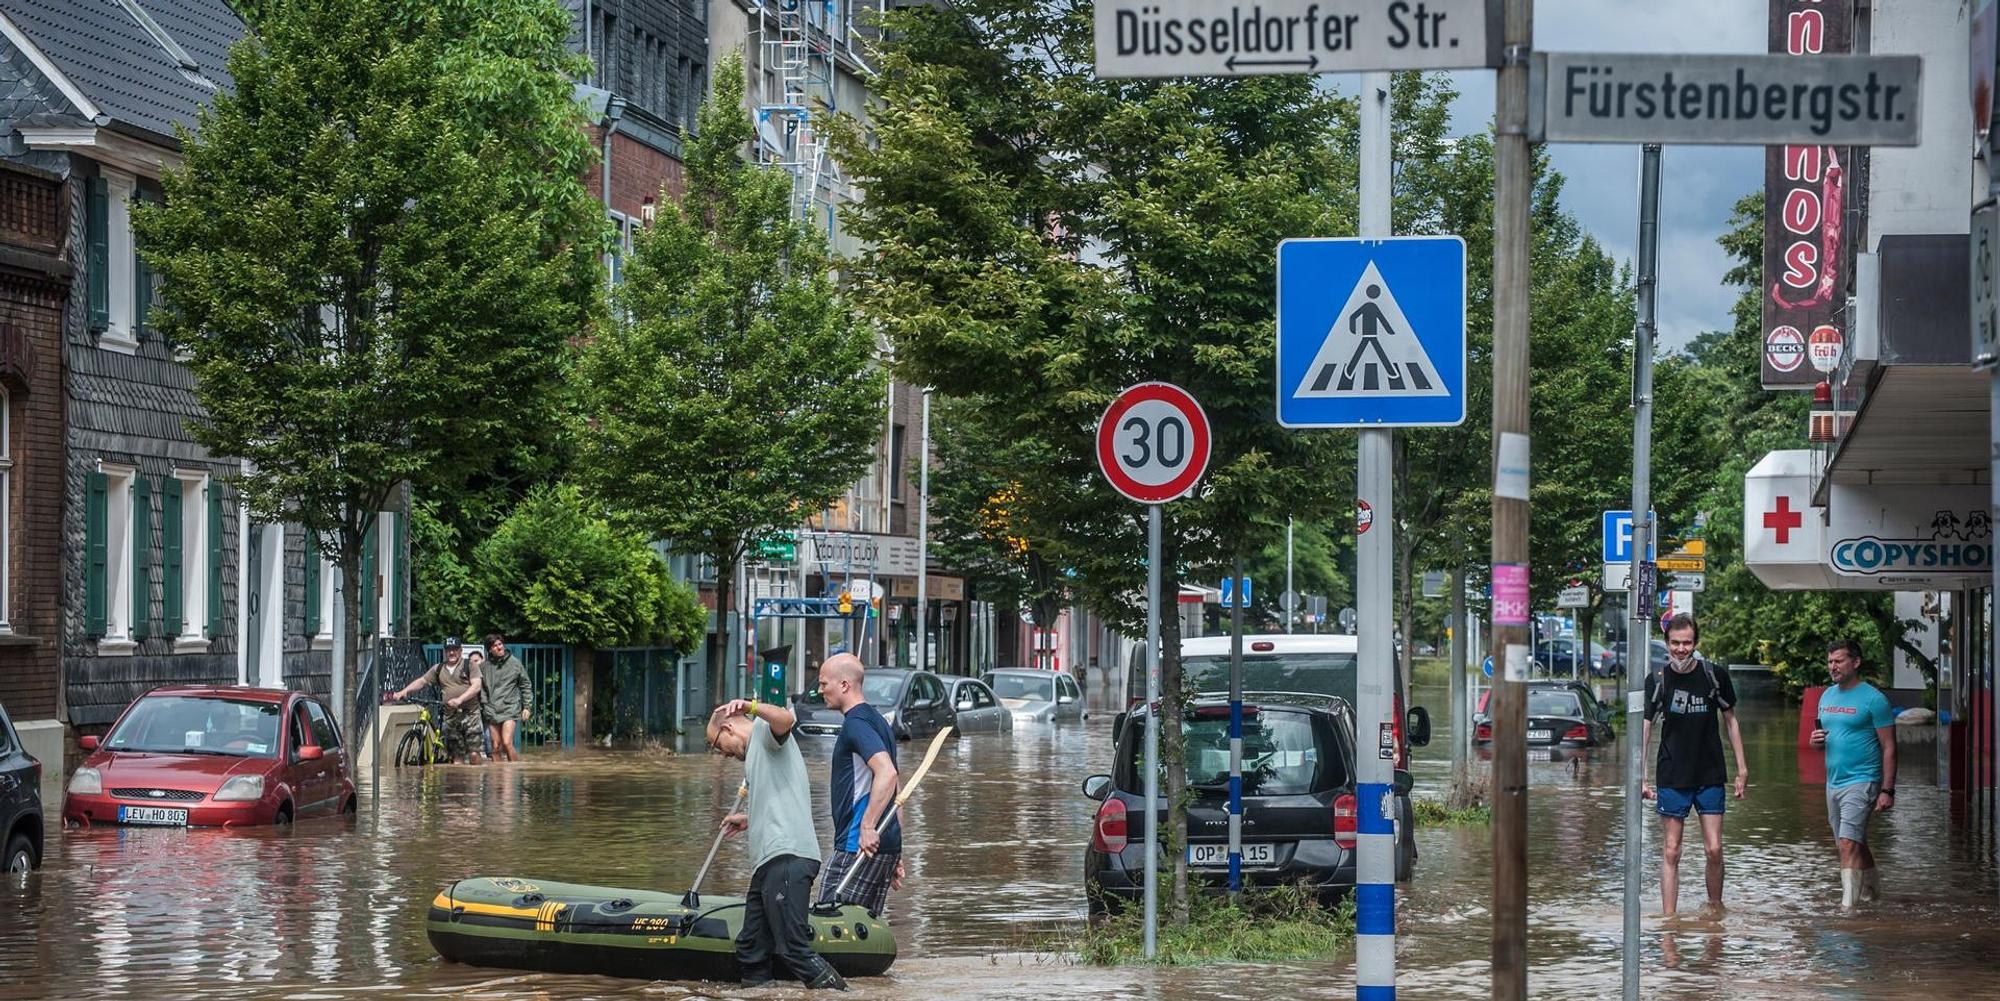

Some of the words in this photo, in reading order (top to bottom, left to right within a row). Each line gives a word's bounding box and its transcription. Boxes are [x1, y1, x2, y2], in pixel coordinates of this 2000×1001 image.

[1116, 6, 1358, 56] Düsseldorfer
[1387, 2, 1459, 49] Str.
[1565, 66, 1905, 135] Fürstenbergstr.
[1815, 345, 1837, 357] früh
[1122, 416, 1185, 468] 30
[1836, 540, 1992, 568] COPYSHO
[771, 664, 780, 677] P
[126, 808, 145, 819] LEV
[151, 810, 165, 821] HO
[168, 810, 186, 822] 803
[1195, 846, 1215, 861] OP
[1250, 846, 1268, 860] 15
[631, 917, 647, 930] HF
[647, 918, 669, 930] 280
